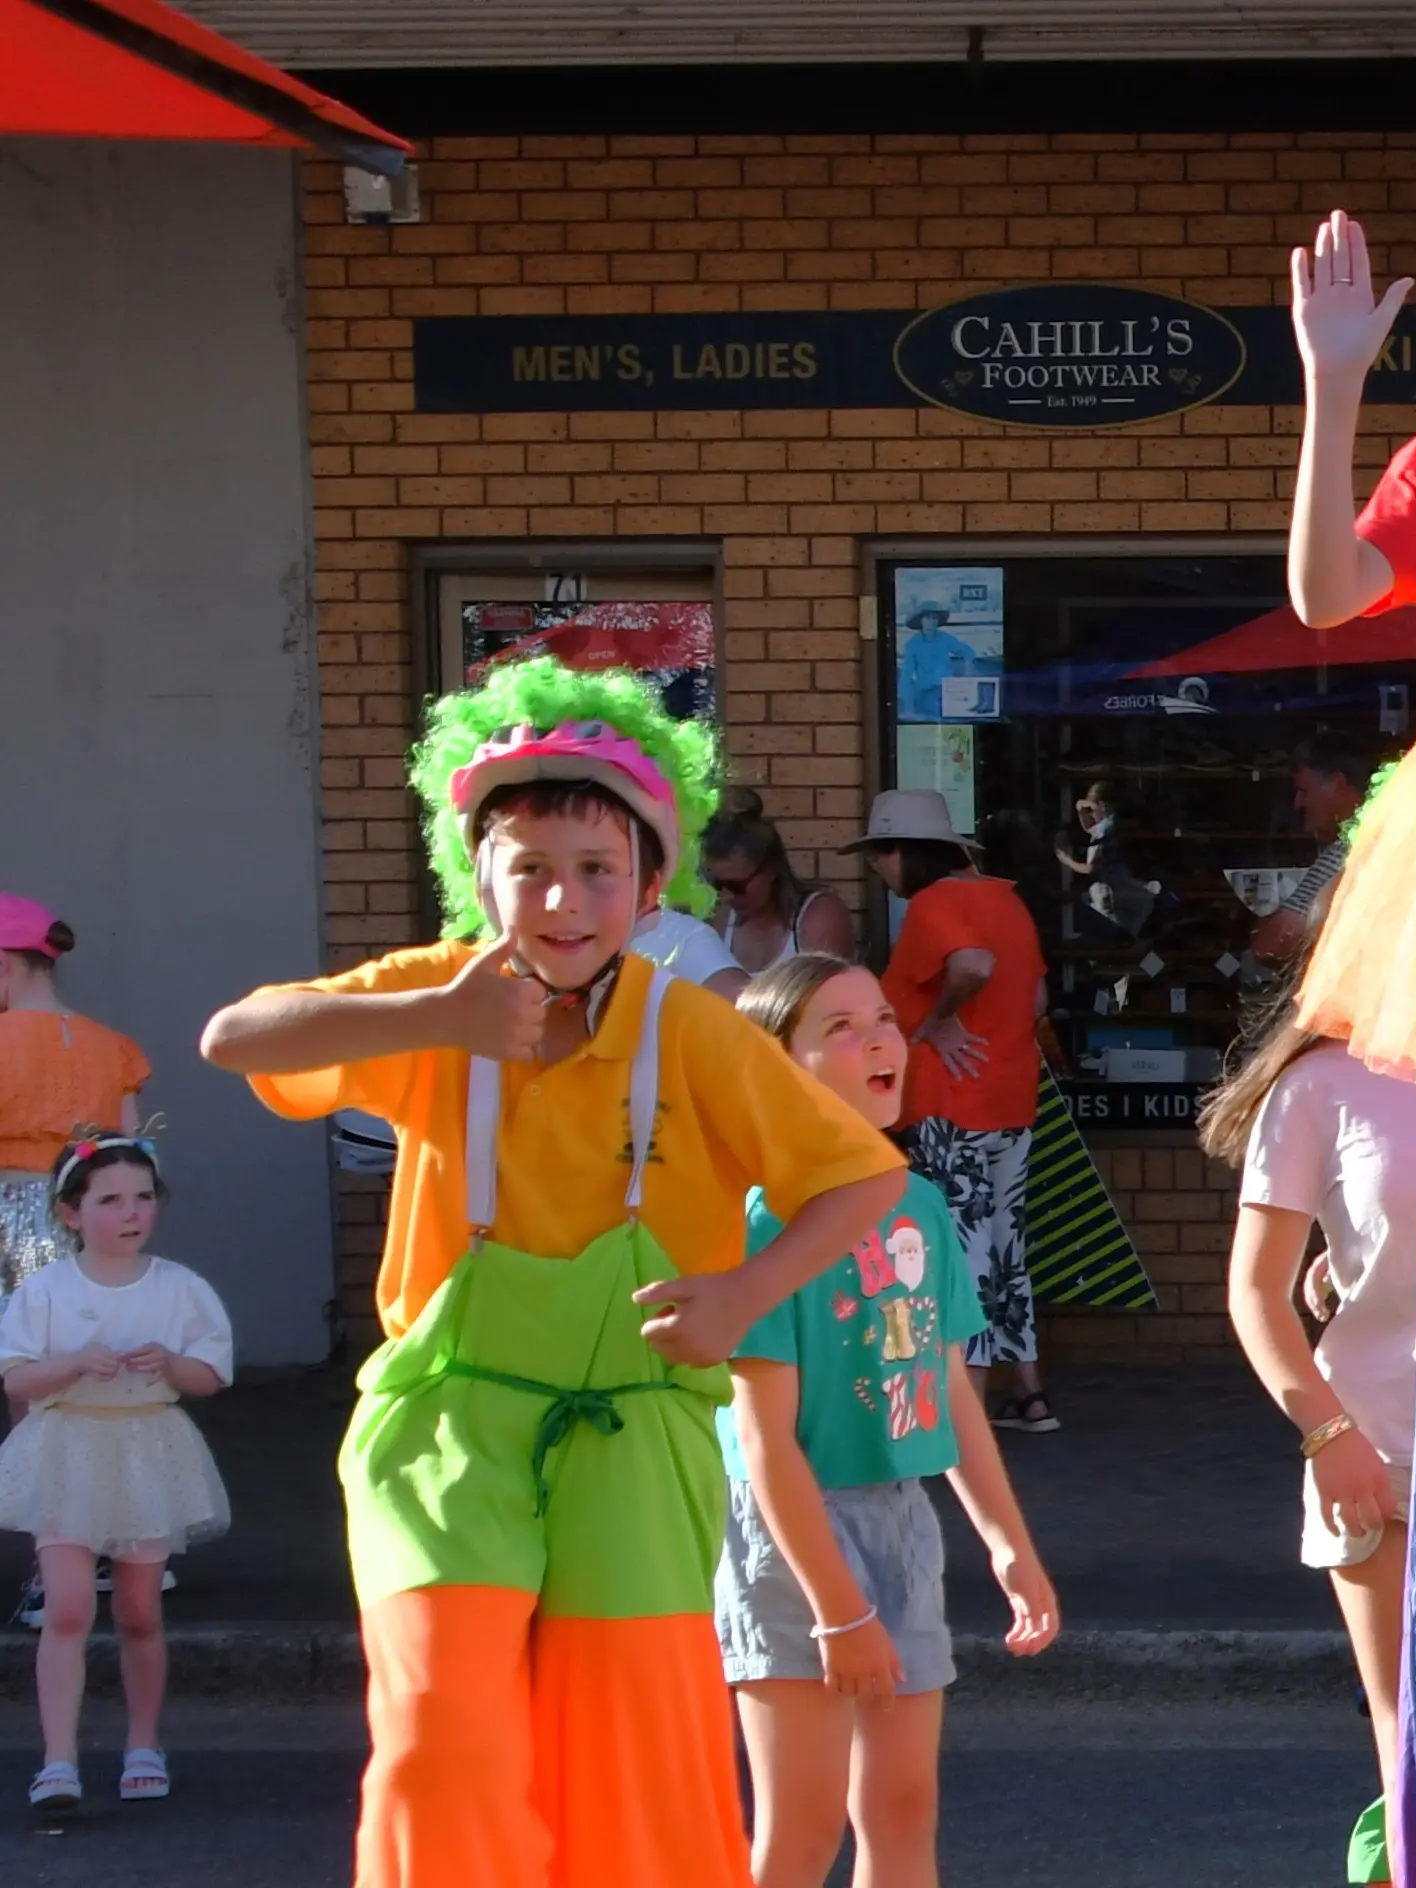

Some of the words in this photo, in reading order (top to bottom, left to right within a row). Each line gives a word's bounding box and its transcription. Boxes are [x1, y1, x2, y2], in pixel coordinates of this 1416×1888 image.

[950, 315, 1195, 360] CAHILL'S
[511, 343, 655, 388] MEN'S,
[670, 341, 818, 380] LADIES
[980, 362, 1163, 389] FOOTWEAR
[1047, 395, 1069, 407] Est.
[1071, 395, 1098, 407] 1949
[549, 573, 582, 602] 71
[587, 650, 616, 660] OPEN
